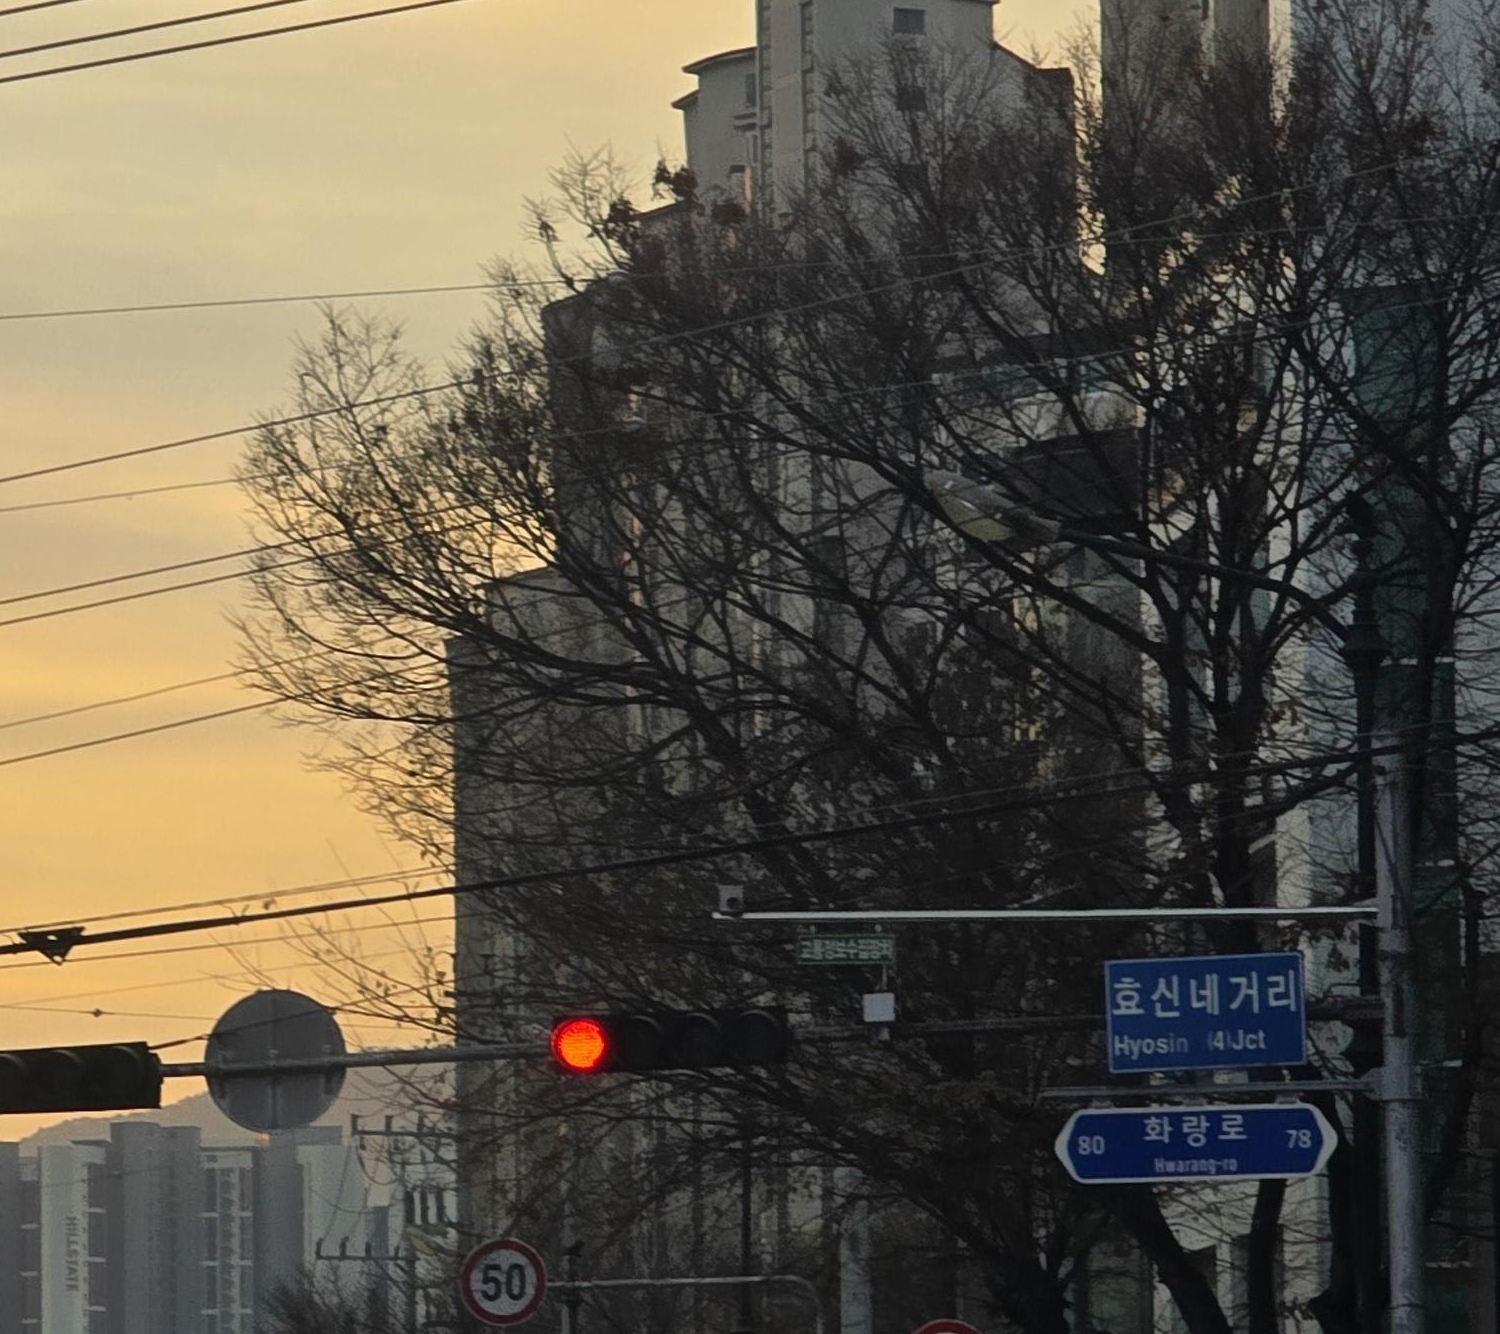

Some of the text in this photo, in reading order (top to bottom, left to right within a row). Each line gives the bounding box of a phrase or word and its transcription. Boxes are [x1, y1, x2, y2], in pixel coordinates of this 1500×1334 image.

[1112, 968, 1297, 1019] 효신네거리
[1113, 1032, 1189, 1061] Hyosin
[1077, 1134, 1106, 1156] 80
[1142, 1113, 1249, 1148] 화랑로
[1285, 1128, 1313, 1151] 78
[1153, 1156, 1239, 1176] Hwarang-ro
[480, 1262, 527, 1303] 50
